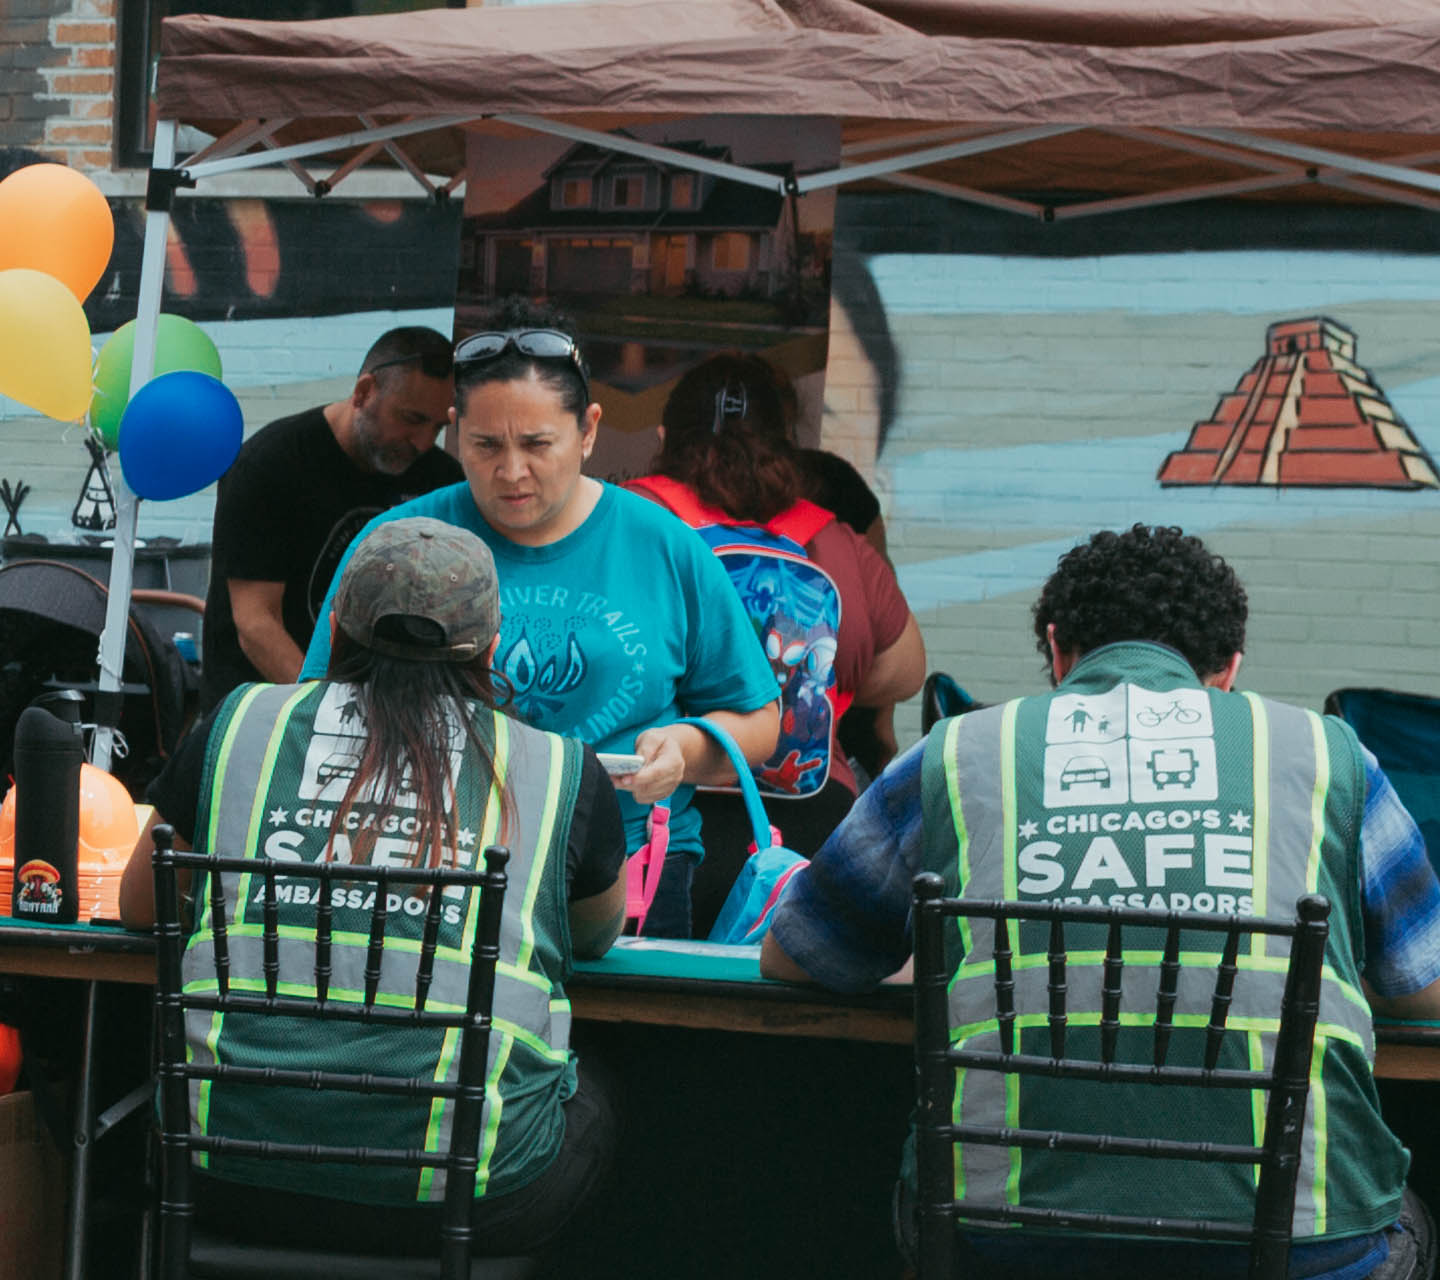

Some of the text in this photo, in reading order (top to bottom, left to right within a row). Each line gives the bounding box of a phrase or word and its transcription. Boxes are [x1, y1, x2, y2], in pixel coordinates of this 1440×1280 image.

[499, 584, 648, 658] IVER TRAILS
[562, 675, 644, 744] LINOIS
[295, 808, 448, 840] CHCAGOS
[1047, 809, 1221, 835] CHICAGO'S
[1018, 834, 1253, 894] SAFE
[253, 885, 462, 924] AMBASSADOS
[1042, 893, 1254, 917] ASSADORS
